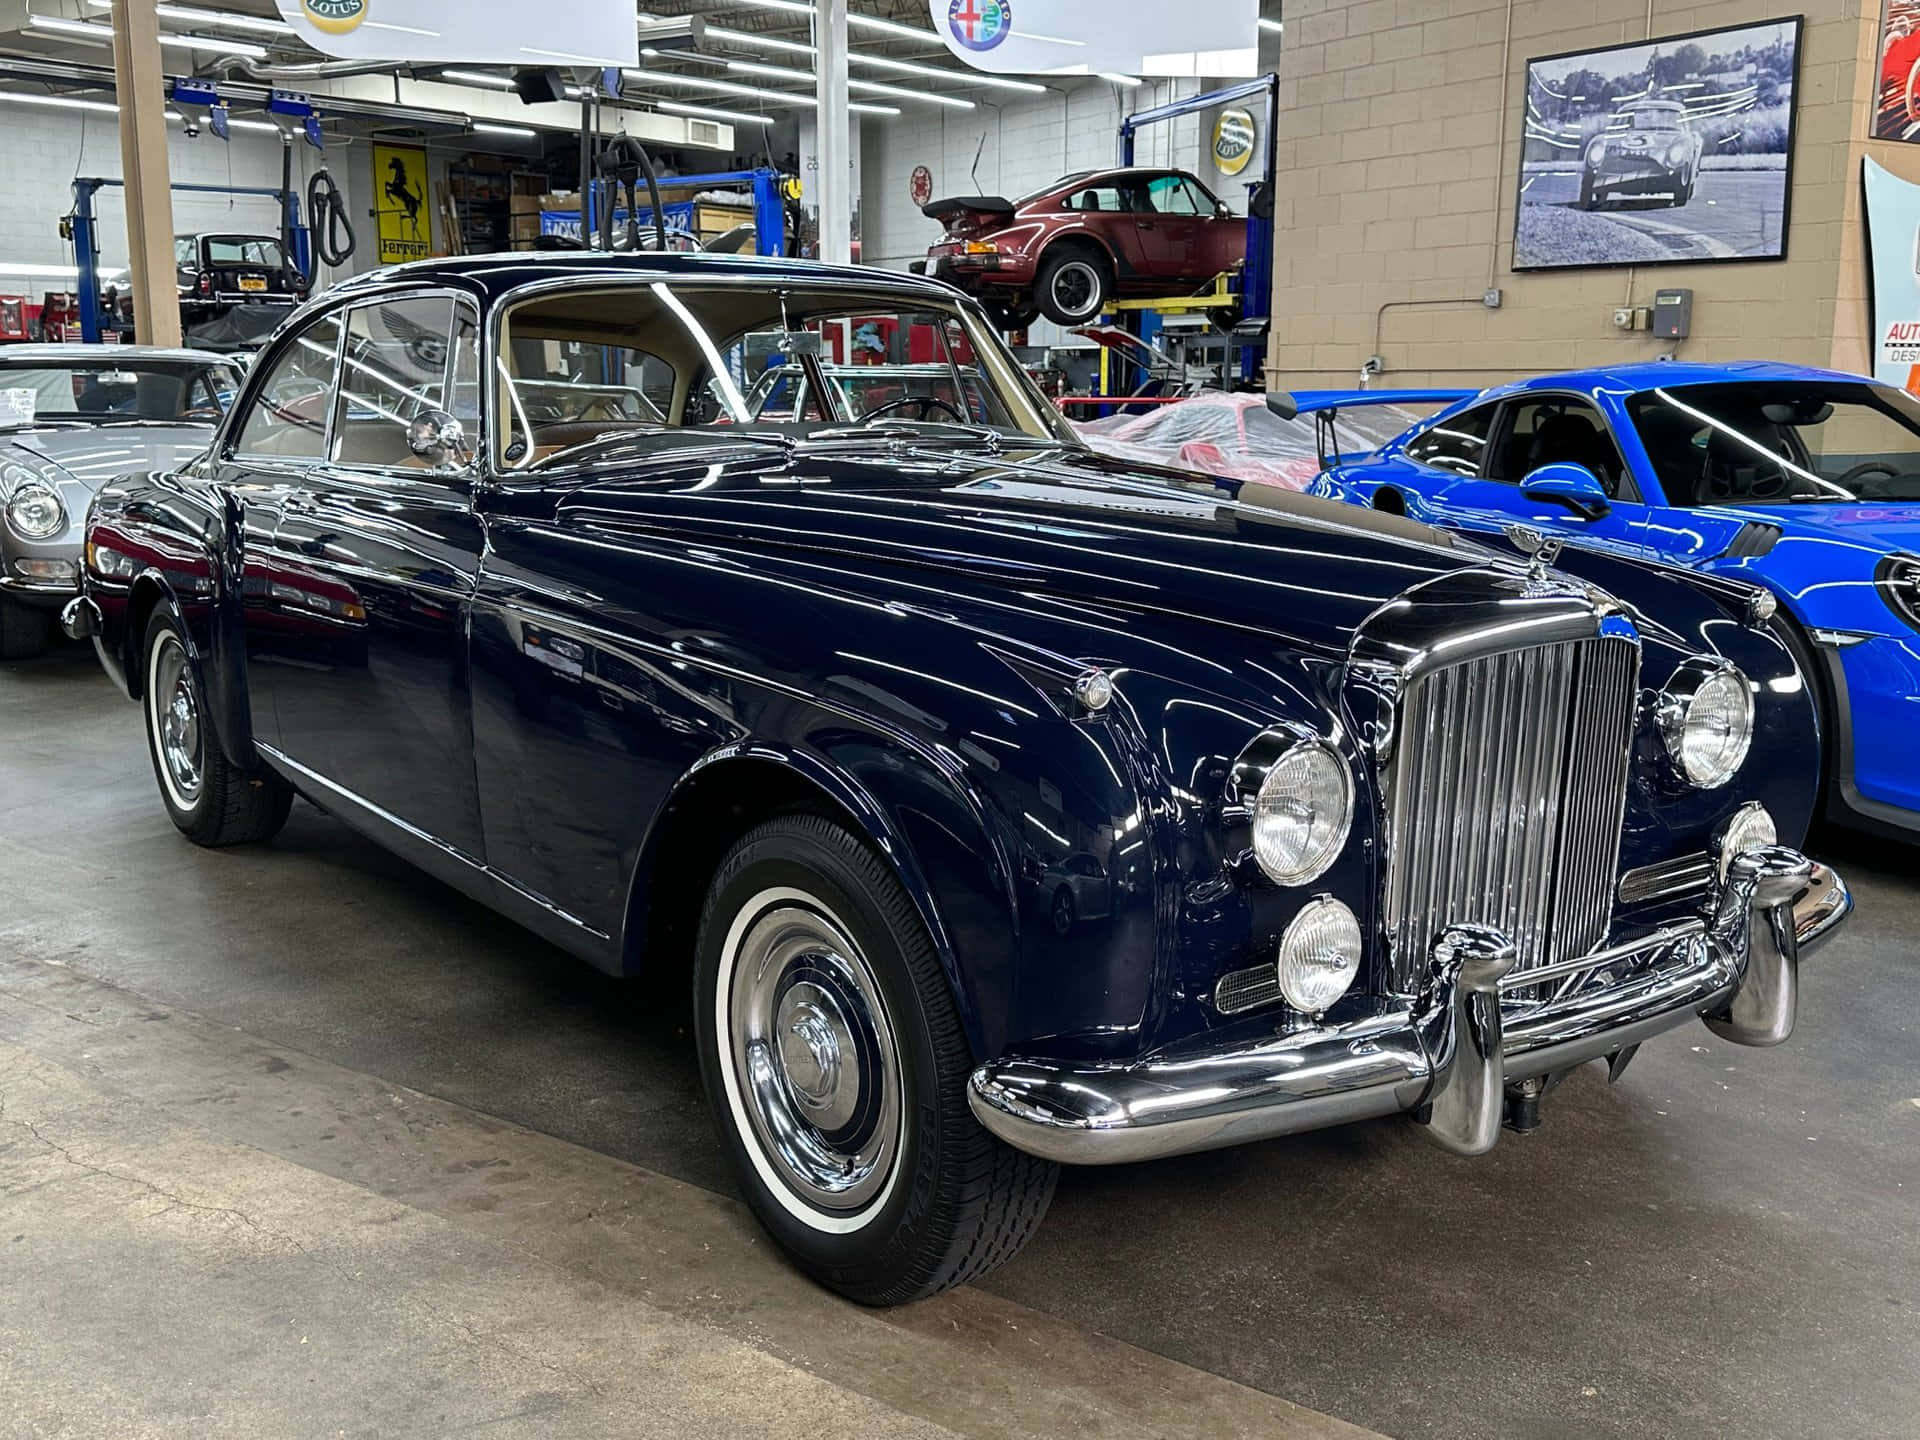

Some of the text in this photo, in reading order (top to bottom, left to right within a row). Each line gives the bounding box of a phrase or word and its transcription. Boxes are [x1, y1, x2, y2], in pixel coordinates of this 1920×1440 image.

[309, 0, 361, 15] LOTUS
[381, 238, 429, 256] Ferrari
[1887, 323, 1920, 340] AUT
